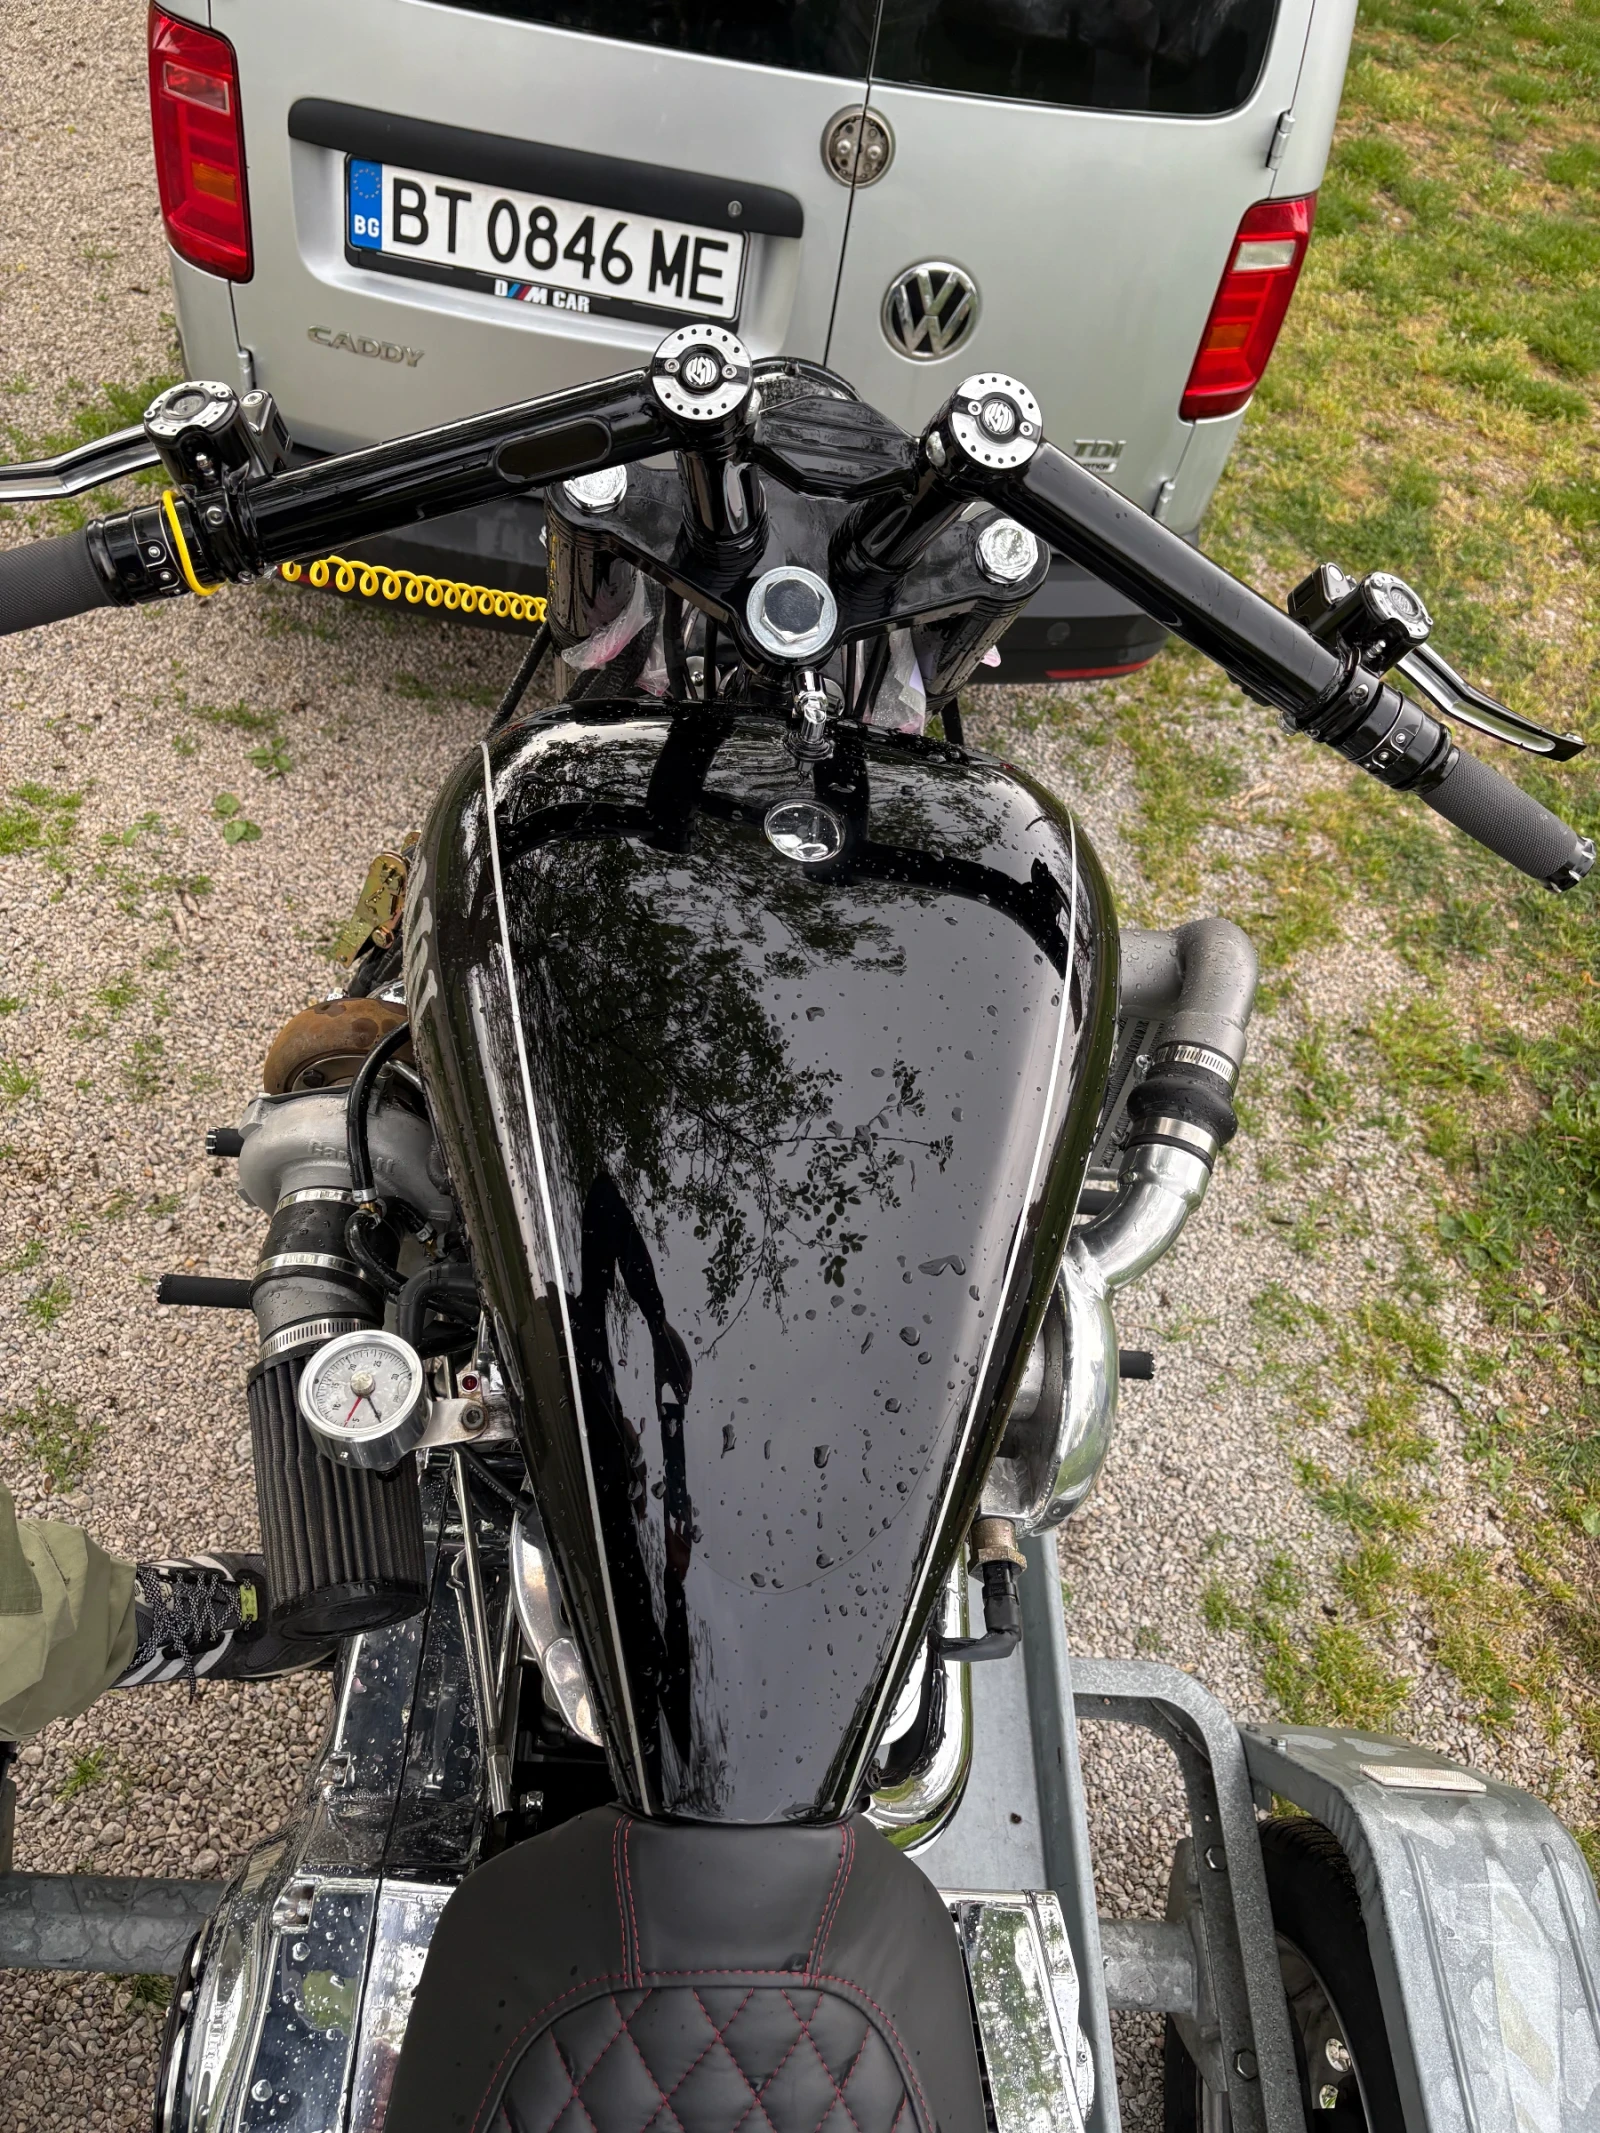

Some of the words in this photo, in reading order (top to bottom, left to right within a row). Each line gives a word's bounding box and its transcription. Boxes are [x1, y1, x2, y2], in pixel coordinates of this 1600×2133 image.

[354, 214, 380, 238] BG
[393, 177, 472, 254] BT
[487, 198, 633, 285] 0846
[648, 228, 729, 306] ME
[552, 291, 590, 313] CAR
[307, 325, 425, 368] CADDY
[1074, 439, 1127, 458] TDI
[308, 1139, 394, 1174] Gartt
